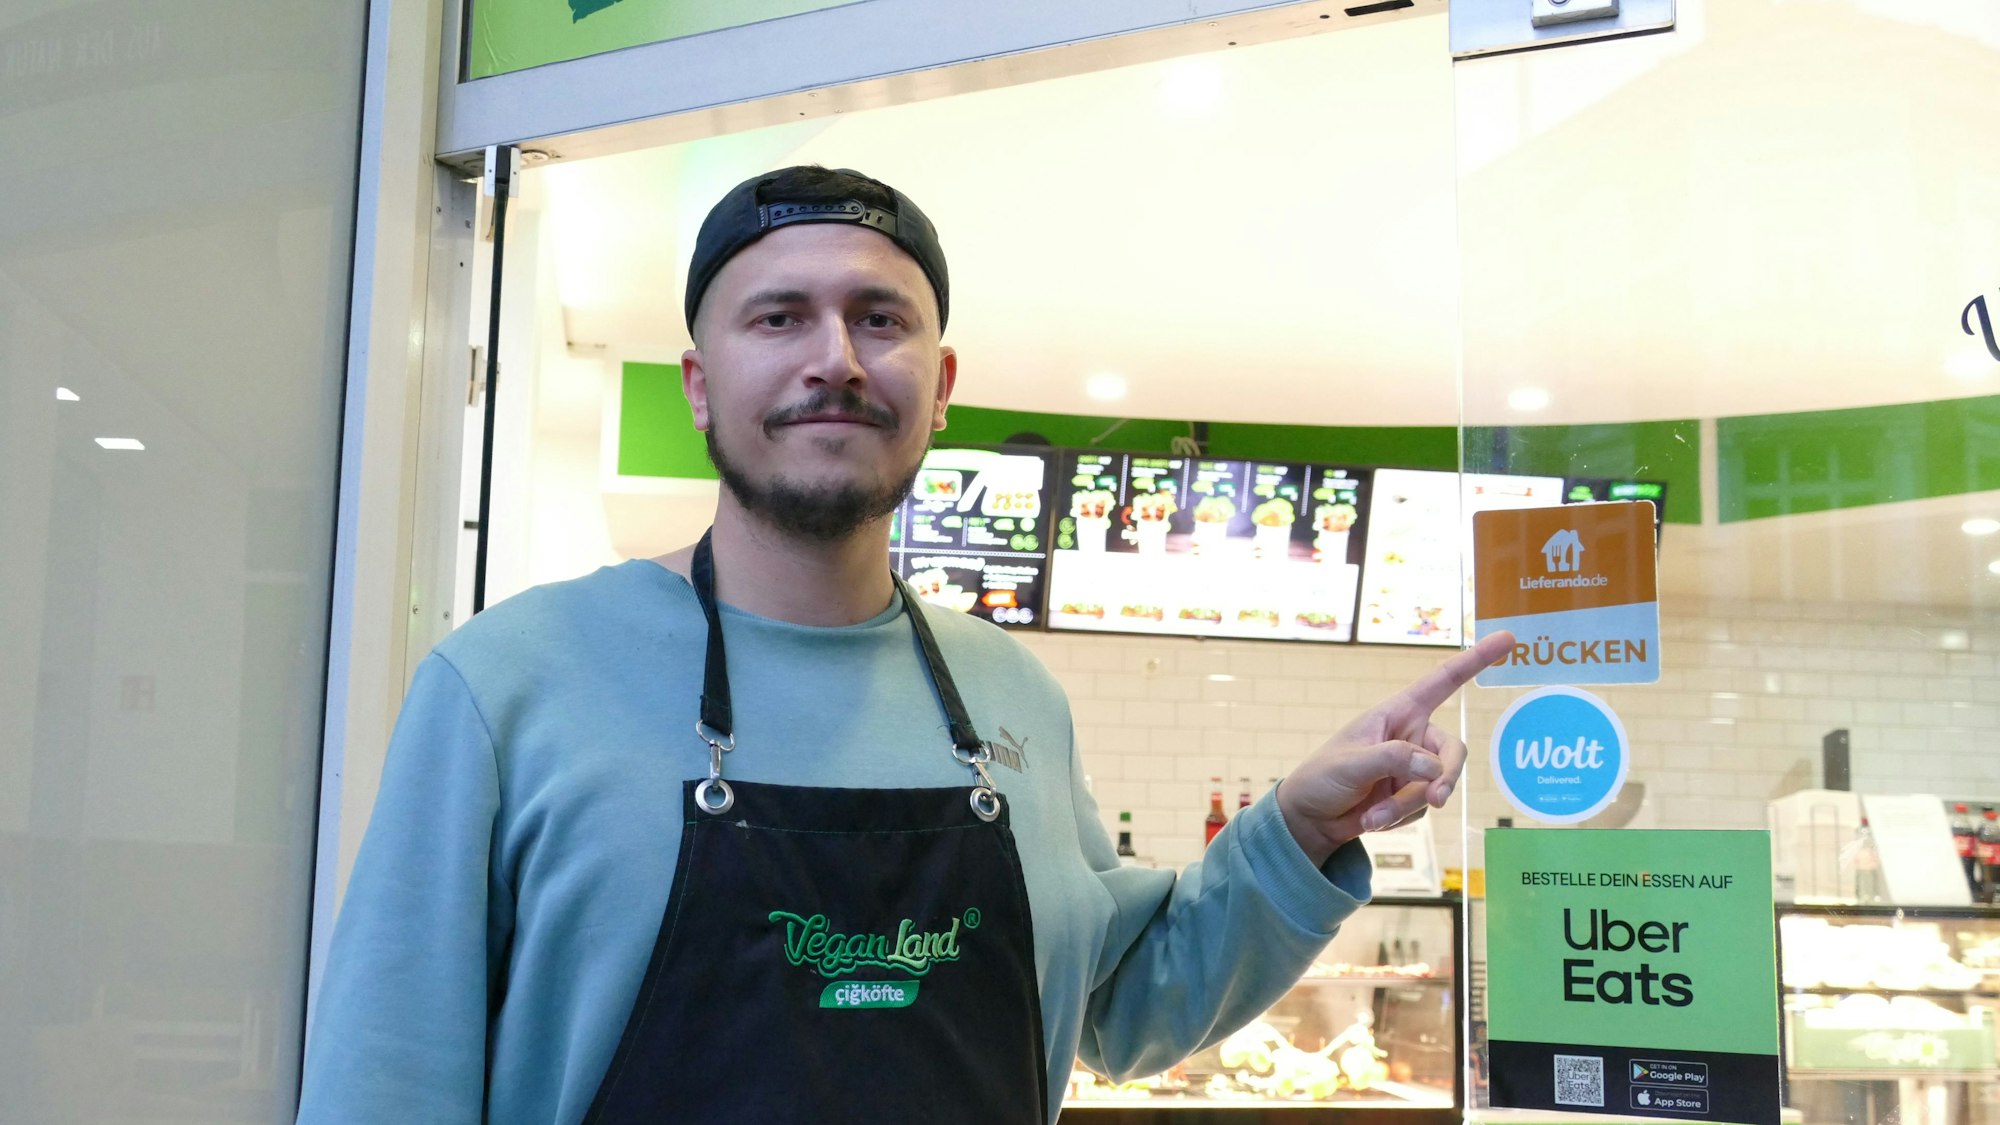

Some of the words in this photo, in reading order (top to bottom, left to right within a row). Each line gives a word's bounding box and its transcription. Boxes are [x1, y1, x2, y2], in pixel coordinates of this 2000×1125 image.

[1519, 573, 1608, 590] Lieferando.de
[1515, 736, 1605, 770] Wolt
[1537, 775, 1582, 785] Delivered.
[1521, 871, 1596, 886] BESTELLE
[1600, 873, 1638, 887] DEIN
[1642, 873, 1695, 889] ESSEN
[1698, 874, 1733, 889] AUF
[1563, 908, 1689, 953] Uber
[768, 910, 888, 970] Vegan
[887, 917, 961, 970] Land
[1563, 958, 1694, 1007] Eats
[835, 983, 905, 1006] çiğköfte
[1567, 1069, 1589, 1080] Uber
[1649, 1070, 1683, 1082] Google
[1684, 1072, 1705, 1084] Play
[1568, 1080, 1590, 1090] Eats
[1654, 1097, 1675, 1108] App
[1676, 1098, 1702, 1108] Store
